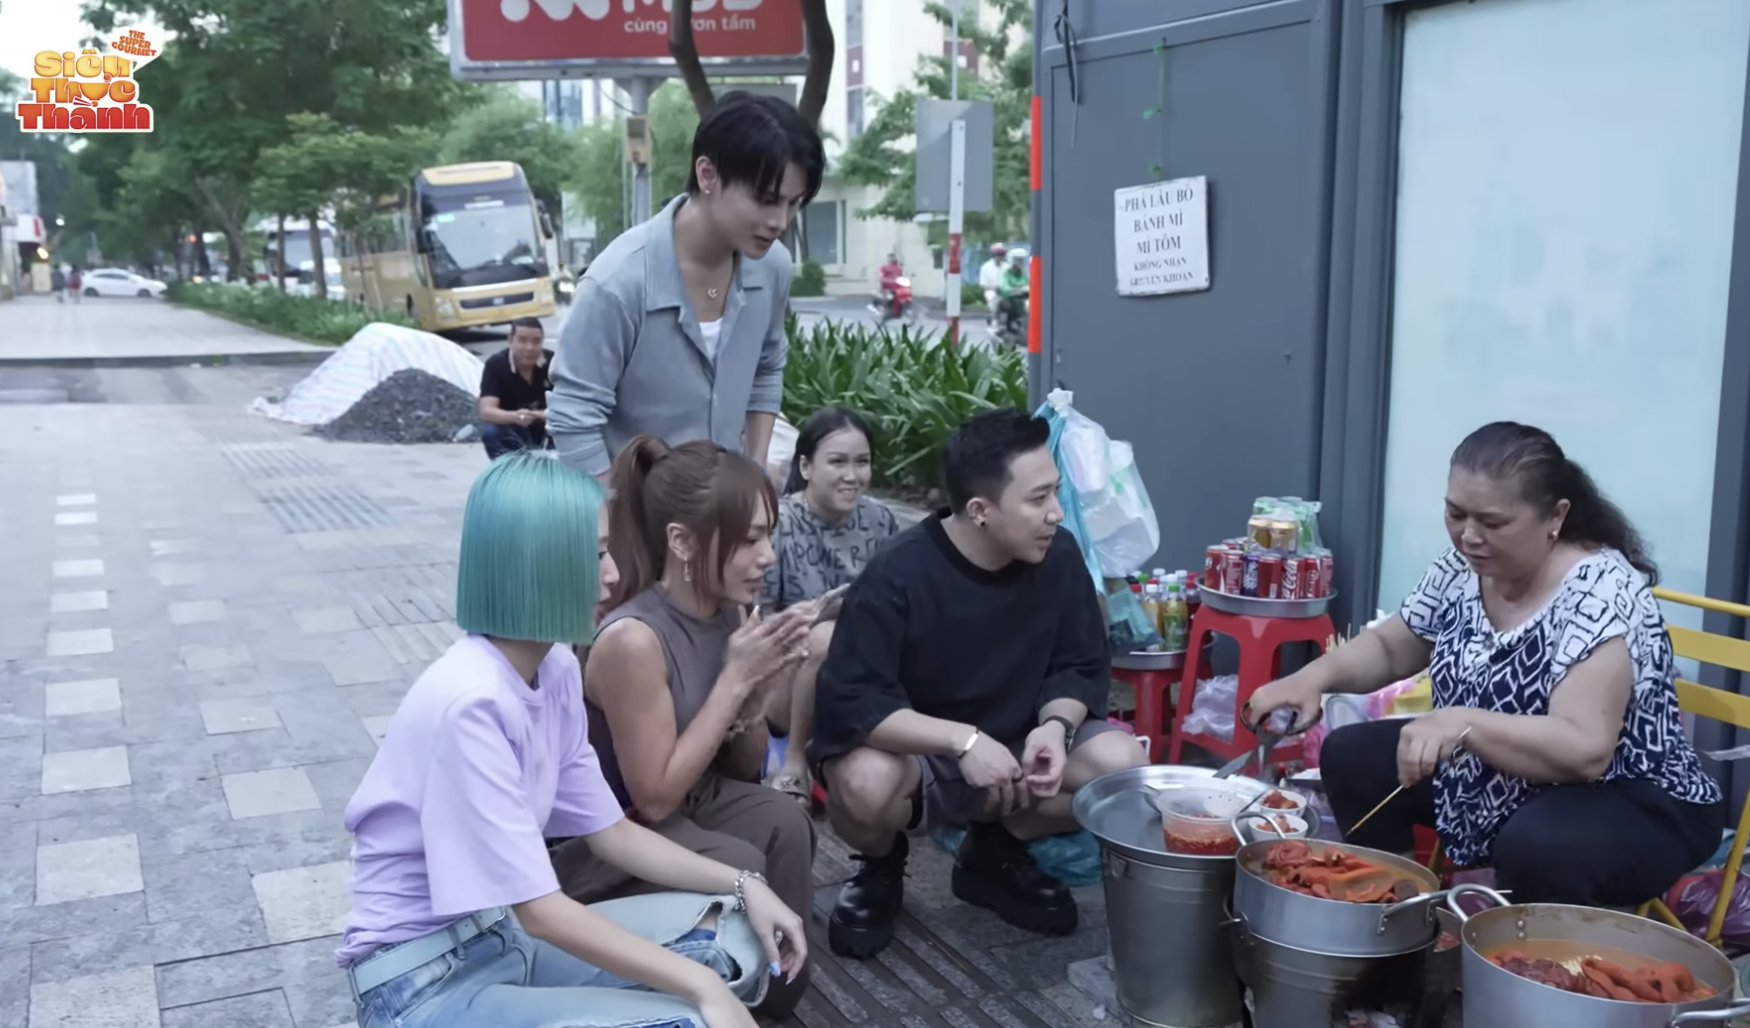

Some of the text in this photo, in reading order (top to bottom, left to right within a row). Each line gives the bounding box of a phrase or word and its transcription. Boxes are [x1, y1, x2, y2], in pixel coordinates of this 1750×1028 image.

[624, 17, 667, 35] cùng
[1125, 192, 1147, 212] PHÁ
[1134, 213, 1165, 233] BÁNH
